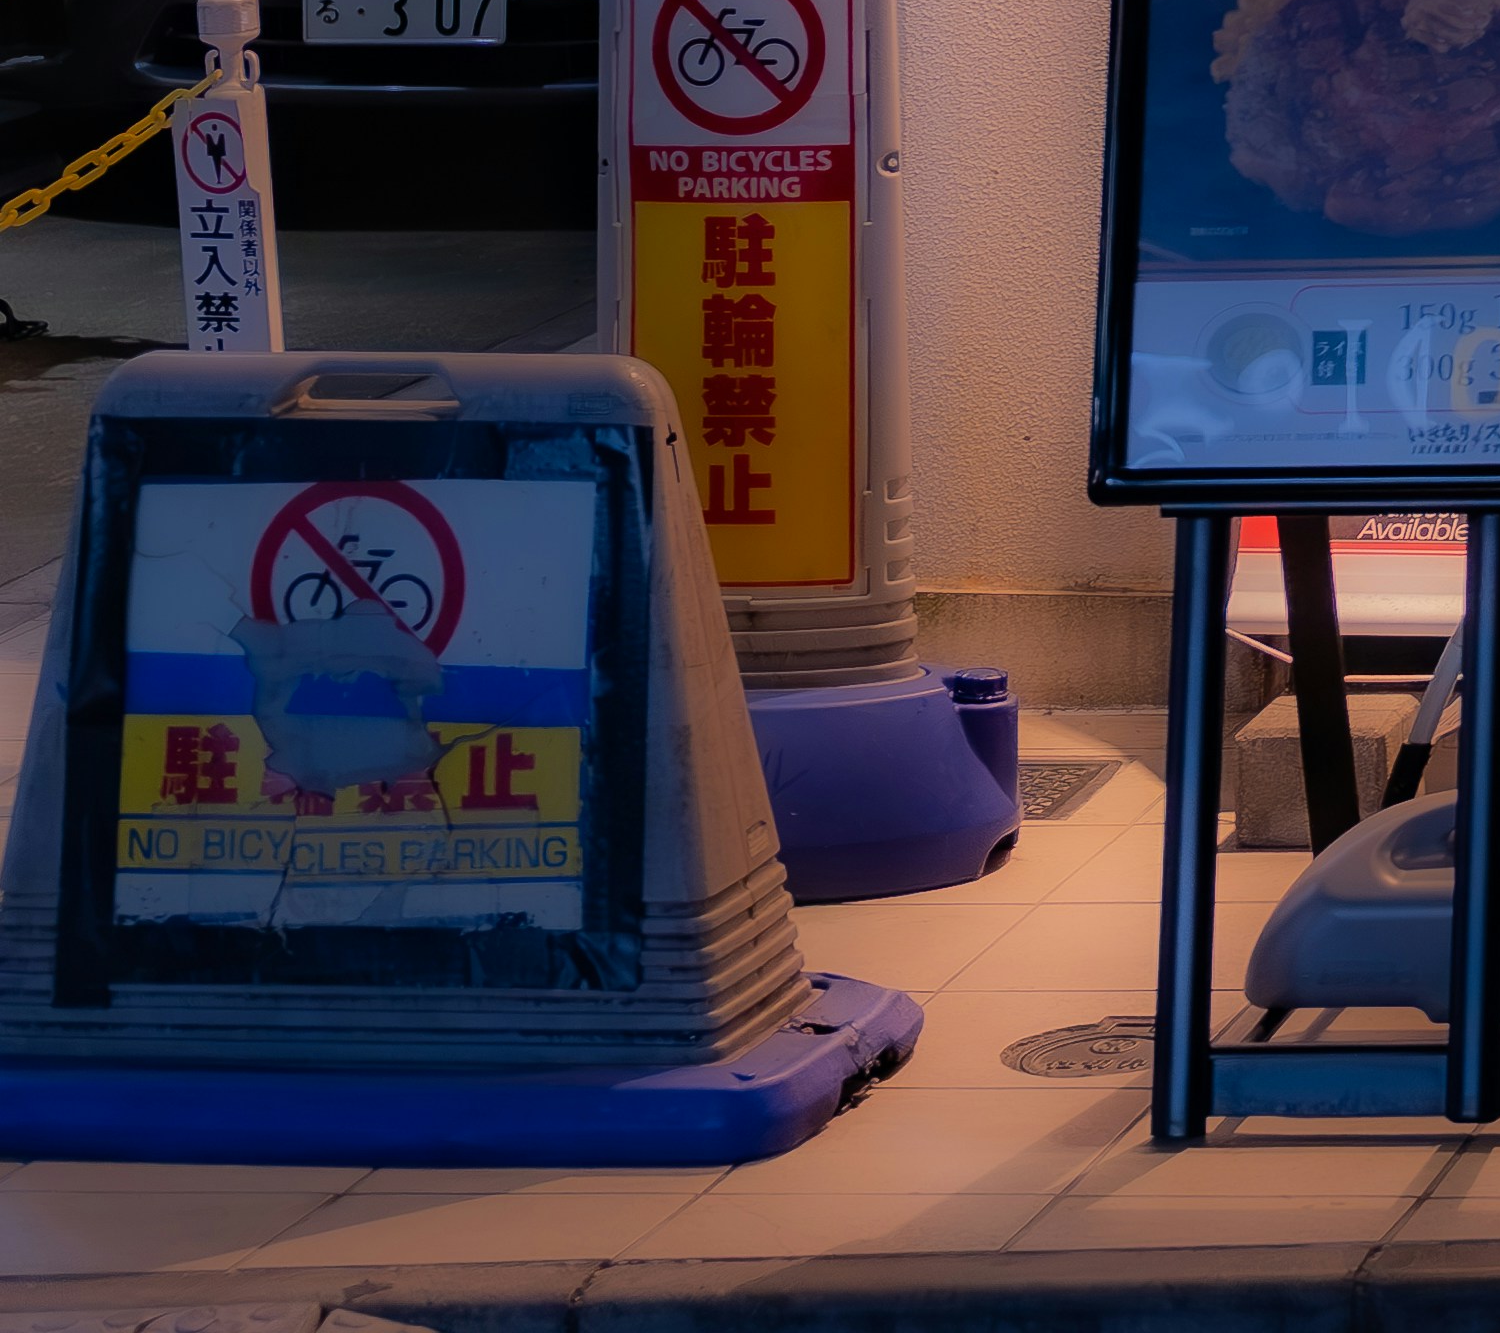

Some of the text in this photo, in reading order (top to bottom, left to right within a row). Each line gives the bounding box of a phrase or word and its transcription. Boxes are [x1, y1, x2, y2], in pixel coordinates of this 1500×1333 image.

[315, 0, 340, 24] る
[648, 150, 834, 173] NO BICYCLES
[677, 176, 803, 200] PARKING
[237, 199, 263, 298] 関係者以外
[189, 199, 242, 351] 立入禁
[1400, 301, 1478, 334] 150g
[702, 212, 777, 528] 駐輪禁止
[1399, 351, 1475, 384] 300g
[1357, 516, 1469, 540] Available
[161, 722, 538, 817] 駐止
[128, 828, 569, 875] NO BICYCLES PARKING
